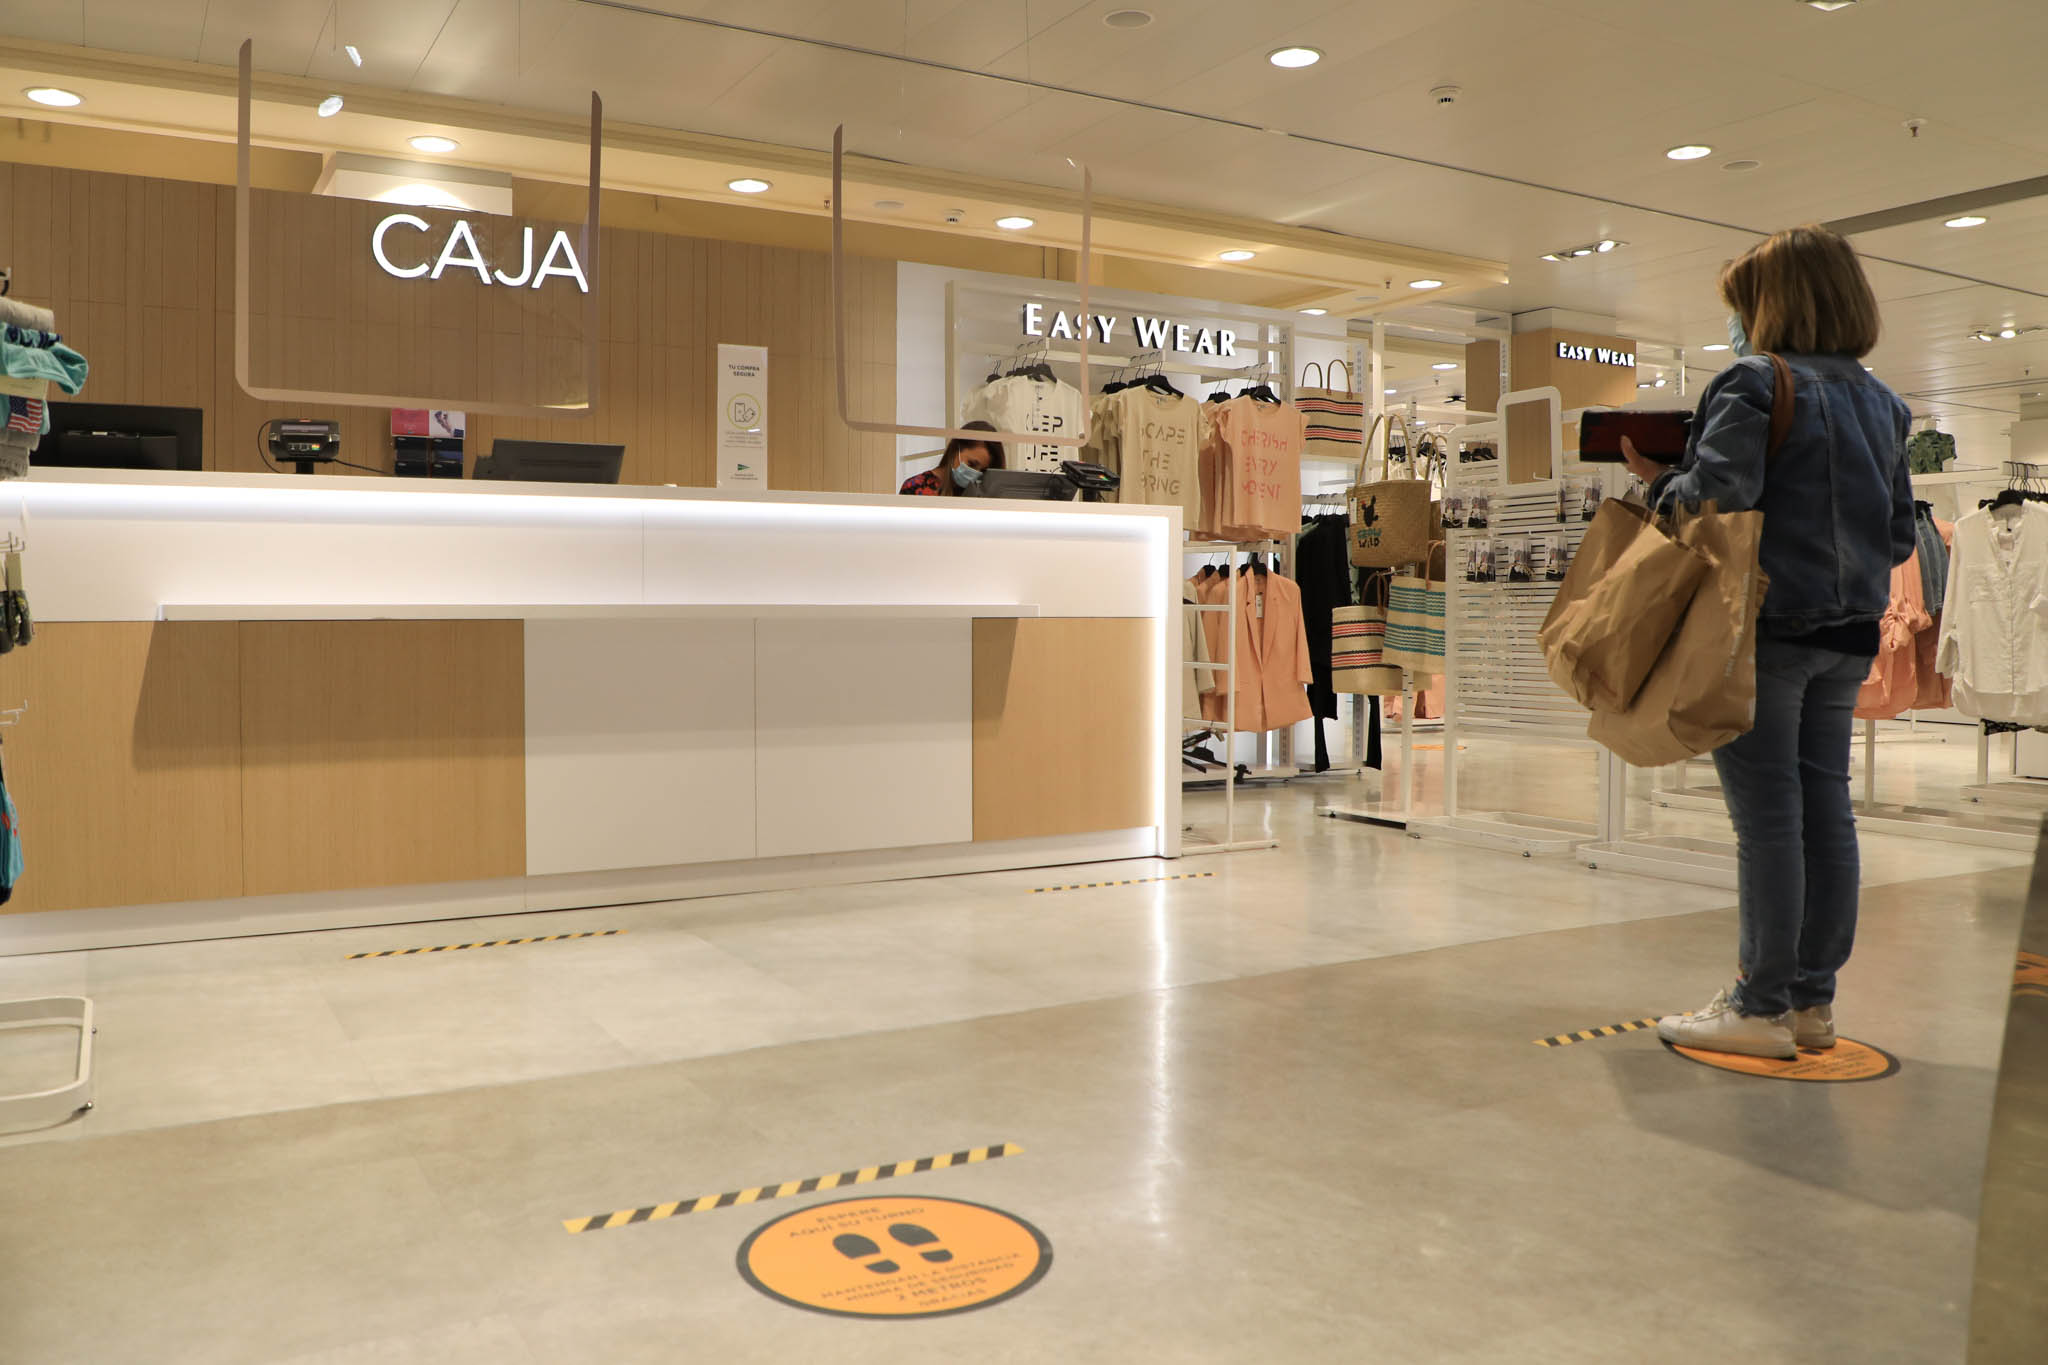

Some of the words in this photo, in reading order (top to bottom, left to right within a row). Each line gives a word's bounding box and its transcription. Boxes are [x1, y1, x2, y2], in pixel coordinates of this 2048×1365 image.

[372, 213, 589, 293] CAJA
[1023, 302, 1116, 344] EASY
[1132, 316, 1236, 356] WEAR
[1557, 341, 1593, 361] EASY
[1595, 347, 1635, 367] WEAR
